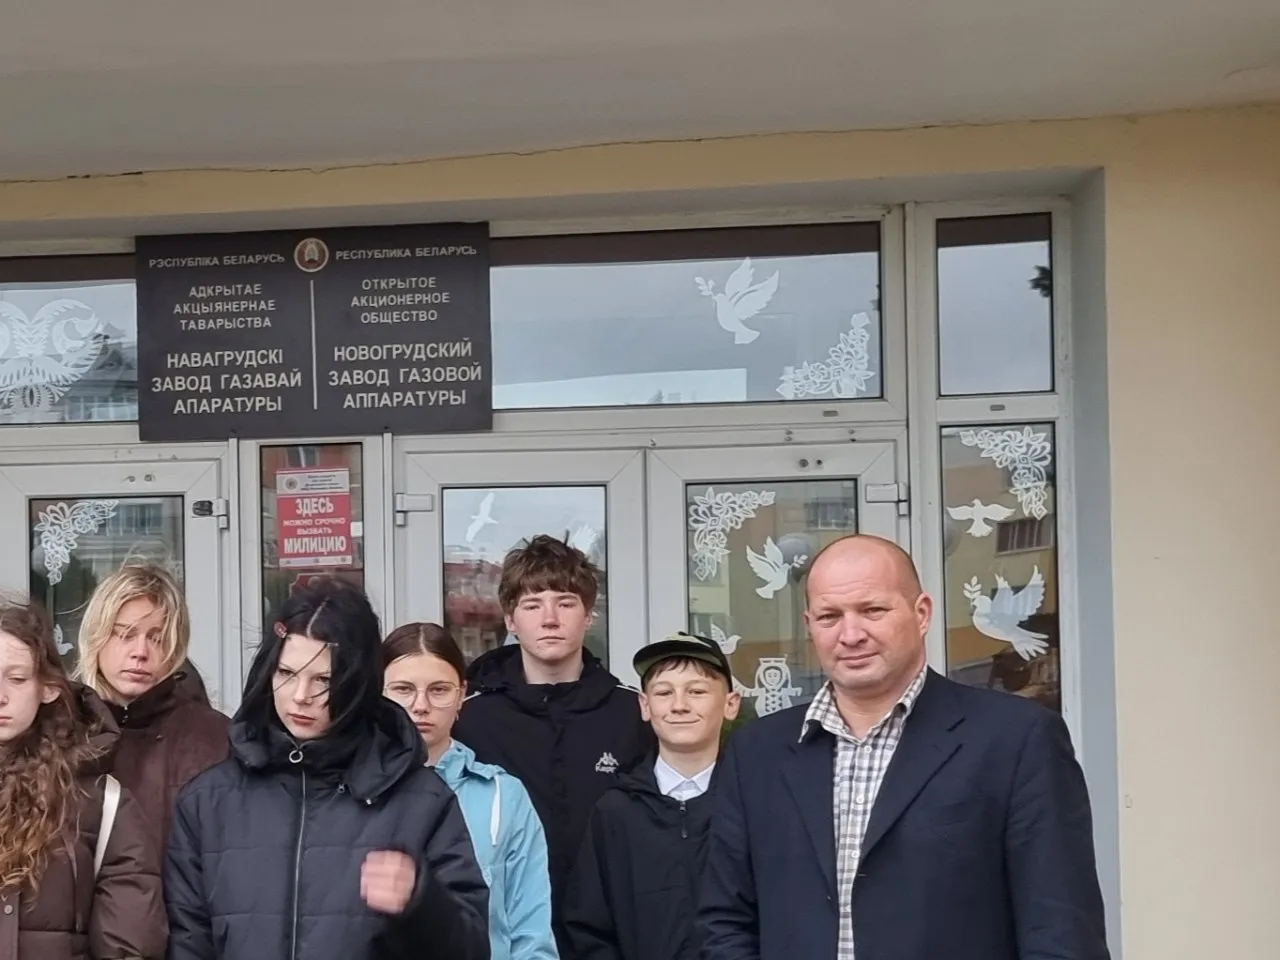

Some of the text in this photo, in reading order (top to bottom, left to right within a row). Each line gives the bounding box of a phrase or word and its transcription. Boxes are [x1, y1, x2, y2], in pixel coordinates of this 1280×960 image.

[149, 253, 285, 268] РЭСПУБЛІКА БЕЛАРУСЬ
[336, 245, 477, 260] РЕСПУБЛИКА БЕЛАРУСЬ
[189, 283, 262, 298] АДКРЫТАЕ
[361, 276, 437, 290] ОТКРЫТОЕ
[173, 299, 277, 315] АКЦЫЯНЕРНАЕ
[350, 292, 451, 308] АКЦИОНЕРНОЕ
[180, 316, 272, 331] ТАВАРЫСТВА
[360, 309, 438, 324] ОБЩЕСТВО
[334, 337, 472, 361] НОВОГРУДСКИЙ
[167, 348, 283, 369] НАВАГРУДСКІ
[151, 368, 302, 393] ЗАВОД ГАЗАВАЙ
[328, 361, 482, 387] ЗАВОД ГАЗОВОЙ
[173, 396, 282, 414] АПАРАТУРЫ
[343, 389, 466, 409] АППАРАТУРЫ
[295, 497, 334, 517] ЗДЕСЬ
[284, 536, 346, 555] МИЛИЦИЮ
